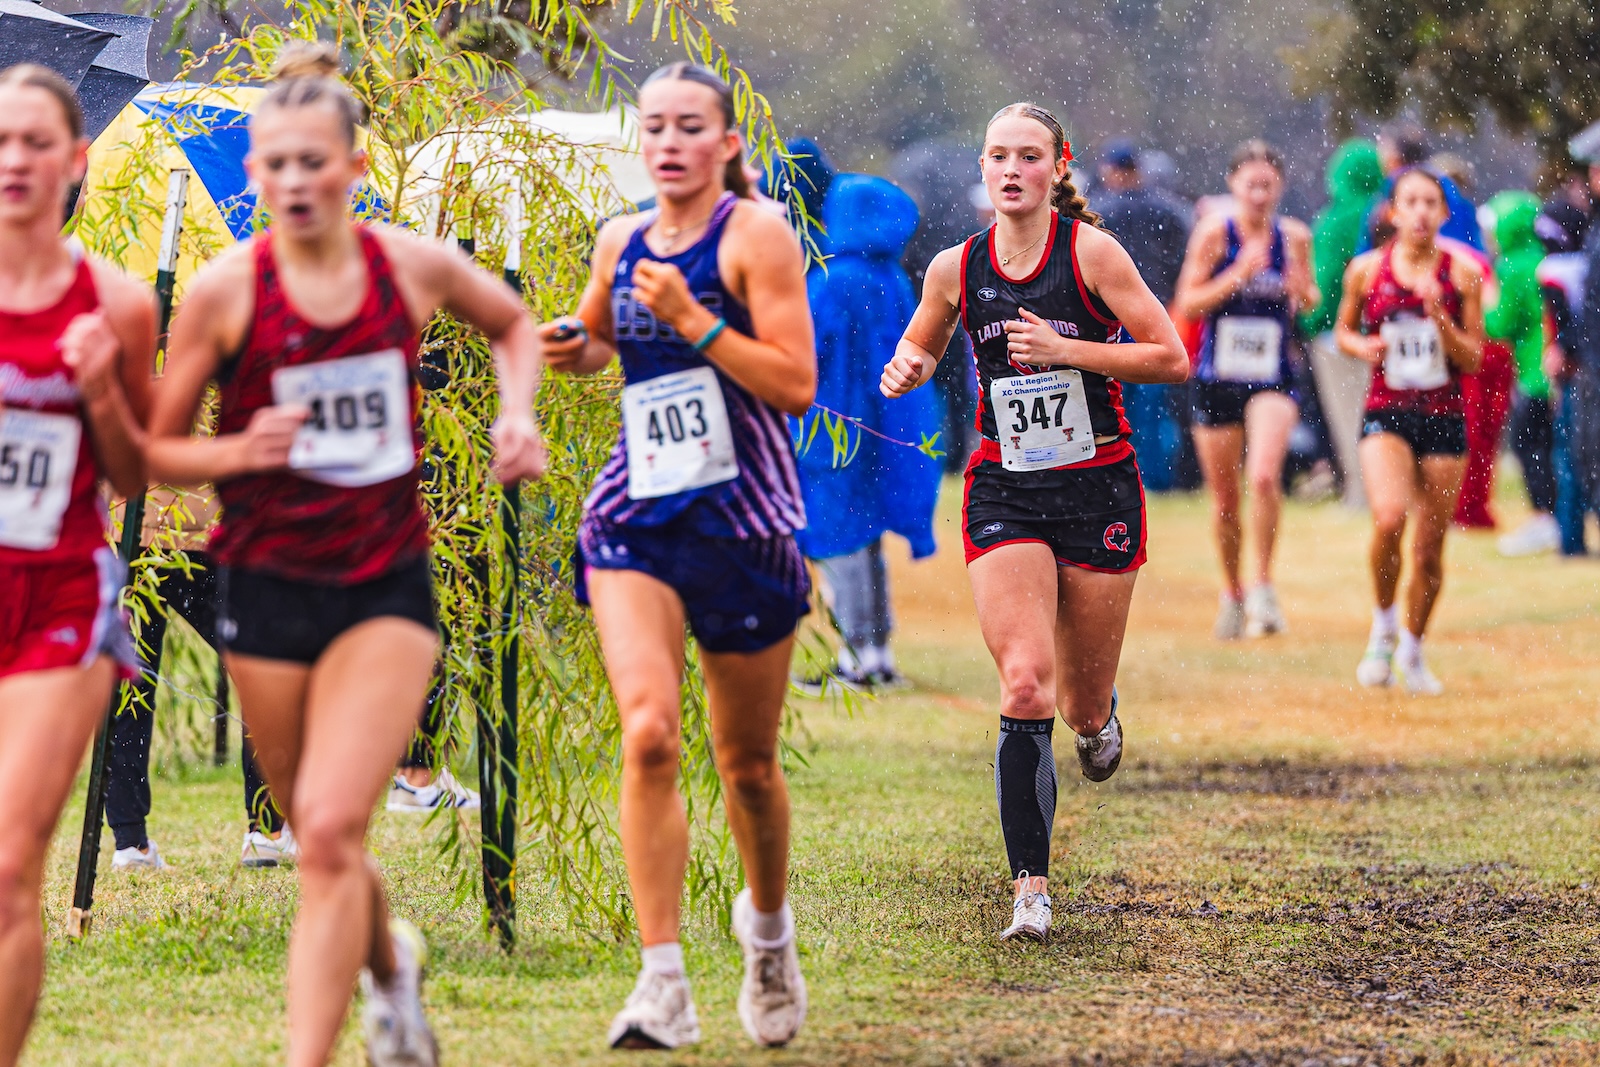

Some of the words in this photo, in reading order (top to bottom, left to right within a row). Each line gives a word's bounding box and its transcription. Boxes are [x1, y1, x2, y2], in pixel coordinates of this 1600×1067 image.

[1002, 389, 1013, 397] XC
[1014, 382, 1070, 396] Championship
[1011, 379, 1023, 387] UIL
[1025, 376, 1053, 387] Region
[304, 389, 388, 431] 409
[647, 398, 708, 446] 403
[1008, 392, 1068, 433] 347
[1081, 445, 1091, 453] 347
